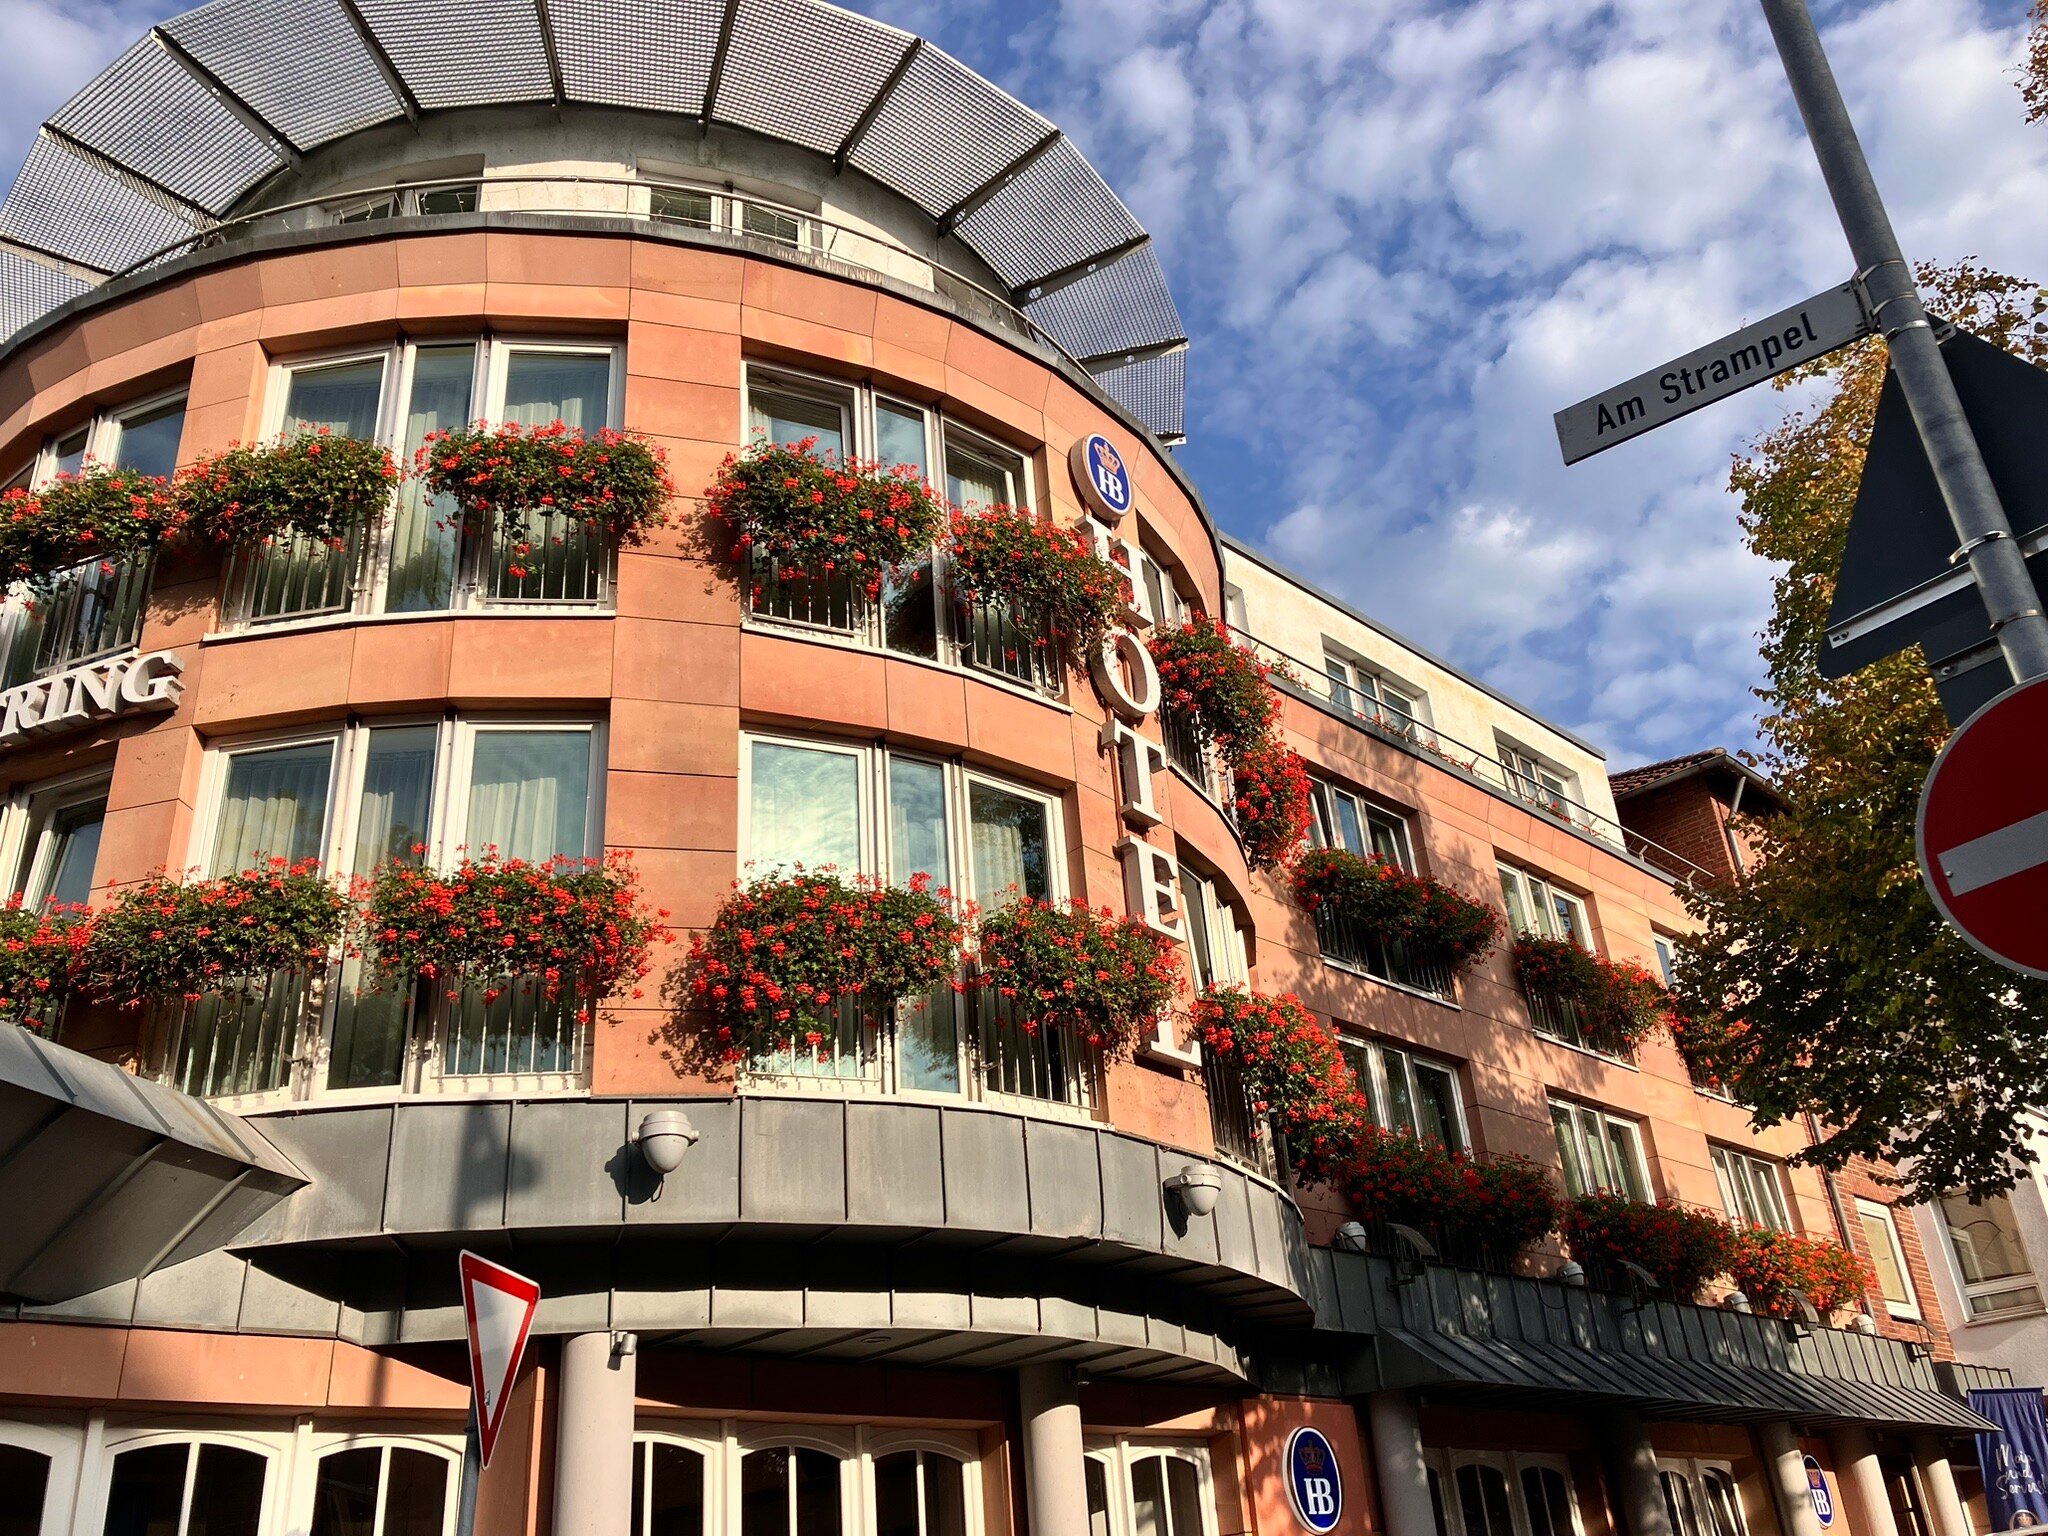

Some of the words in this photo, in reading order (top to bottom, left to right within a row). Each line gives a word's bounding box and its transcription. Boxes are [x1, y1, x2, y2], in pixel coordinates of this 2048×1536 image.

[1597, 396, 1646, 436] Am
[1659, 312, 1818, 404] Strampel
[1097, 464, 1124, 504] HB
[0, 650, 182, 738] RING
[1304, 1478, 1334, 1515] HB
[1811, 1489, 1831, 1515] HB
